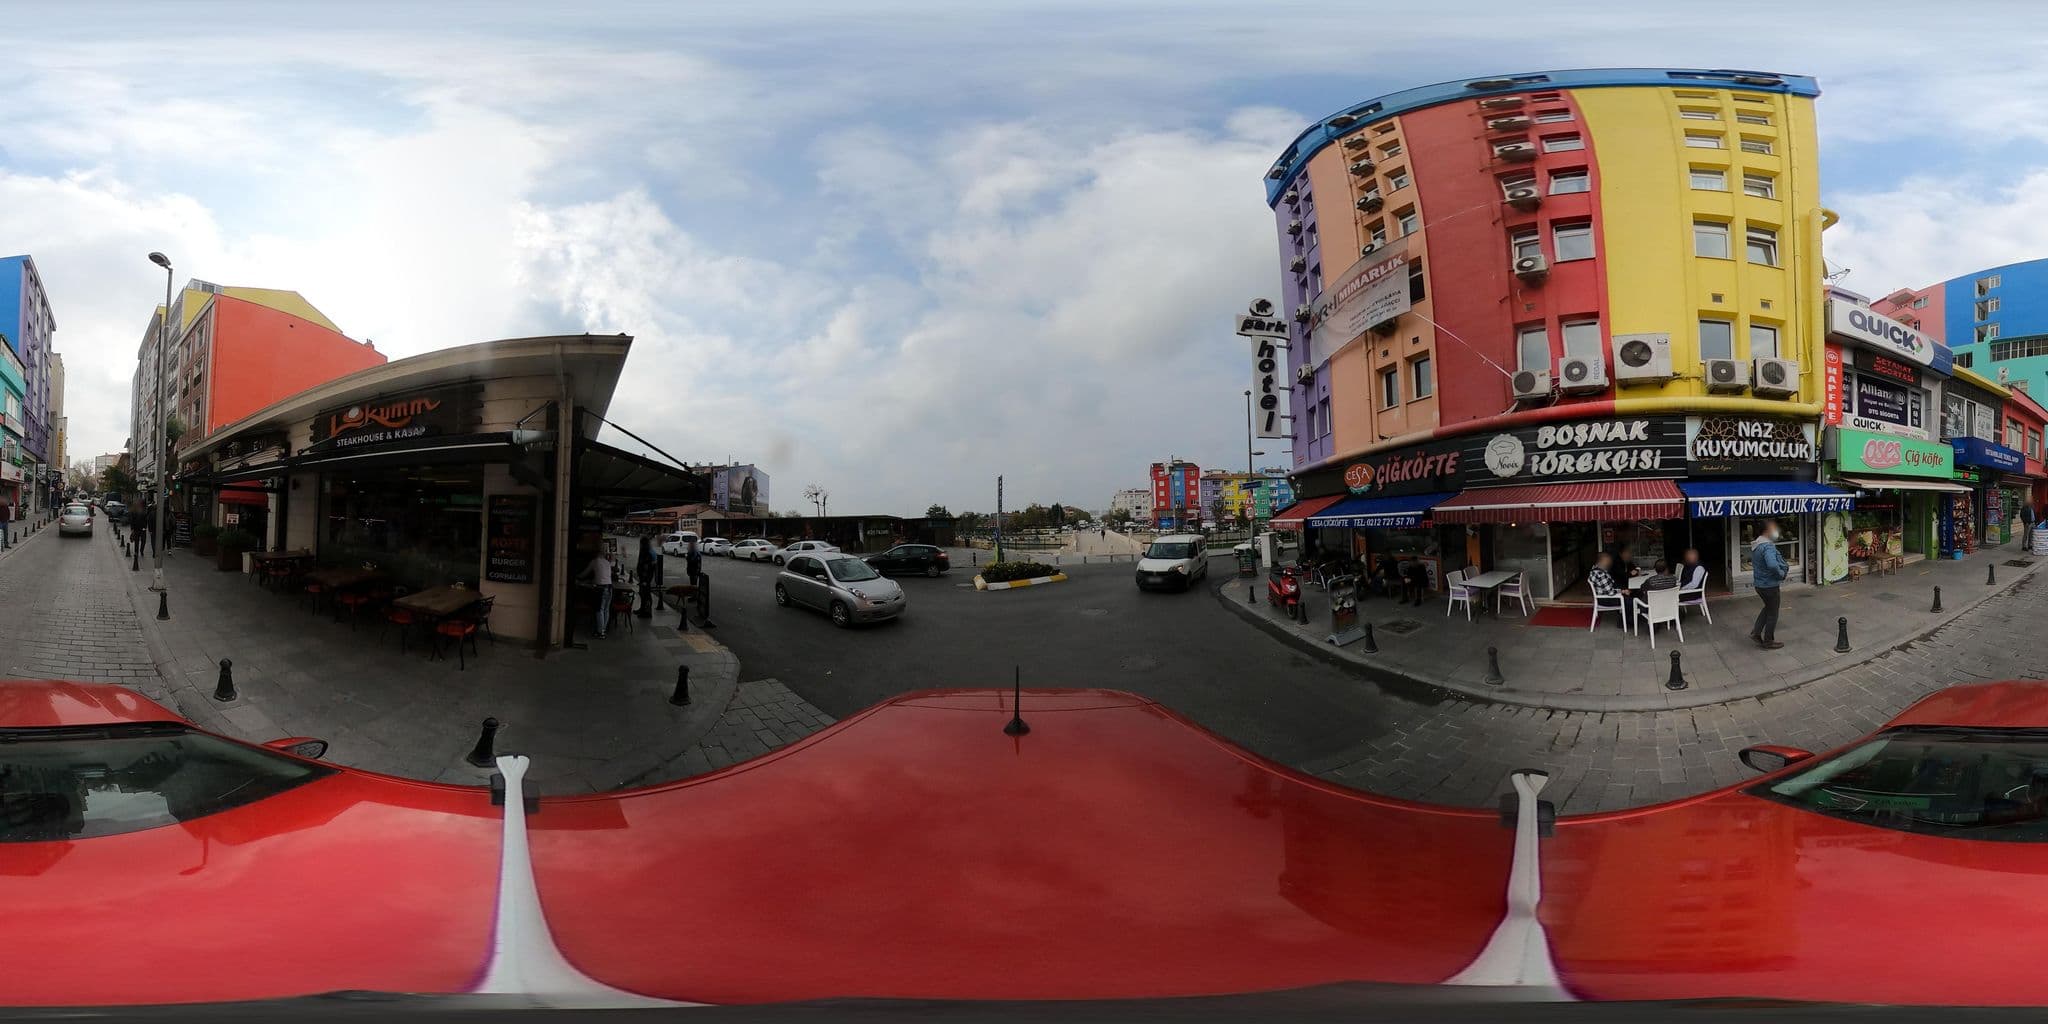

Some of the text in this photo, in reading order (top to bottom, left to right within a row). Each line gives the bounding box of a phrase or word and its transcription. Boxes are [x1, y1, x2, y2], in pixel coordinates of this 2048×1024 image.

[1240, 319, 1288, 333] park
[1849, 310, 1915, 350] QUICK
[1257, 340, 1278, 432] hotel
[1826, 366, 1838, 420] MAPFRE
[1738, 421, 1774, 439] NAZ
[1853, 418, 1882, 431] QUICK
[336, 431, 383, 447] STEAKHOUSE
[386, 432, 392, 440] &
[1536, 420, 1649, 449] BOŞNAK
[1696, 439, 1809, 459] KUYUMCULUK
[1905, 449, 1944, 468] Çiğ köfte
[1346, 466, 1370, 486] CESA
[1376, 451, 1460, 491] ÇİĞKÖFTE
[1698, 500, 1724, 517] NAZ
[1730, 499, 1809, 516] KUYUMCULUK
[1811, 499, 1827, 513] 727
[1829, 499, 1839, 512] 57
[1840, 498, 1851, 511] 74
[1312, 519, 1324, 527] CESA
[1382, 518, 1395, 526] 727
[1396, 517, 1405, 526] 57
